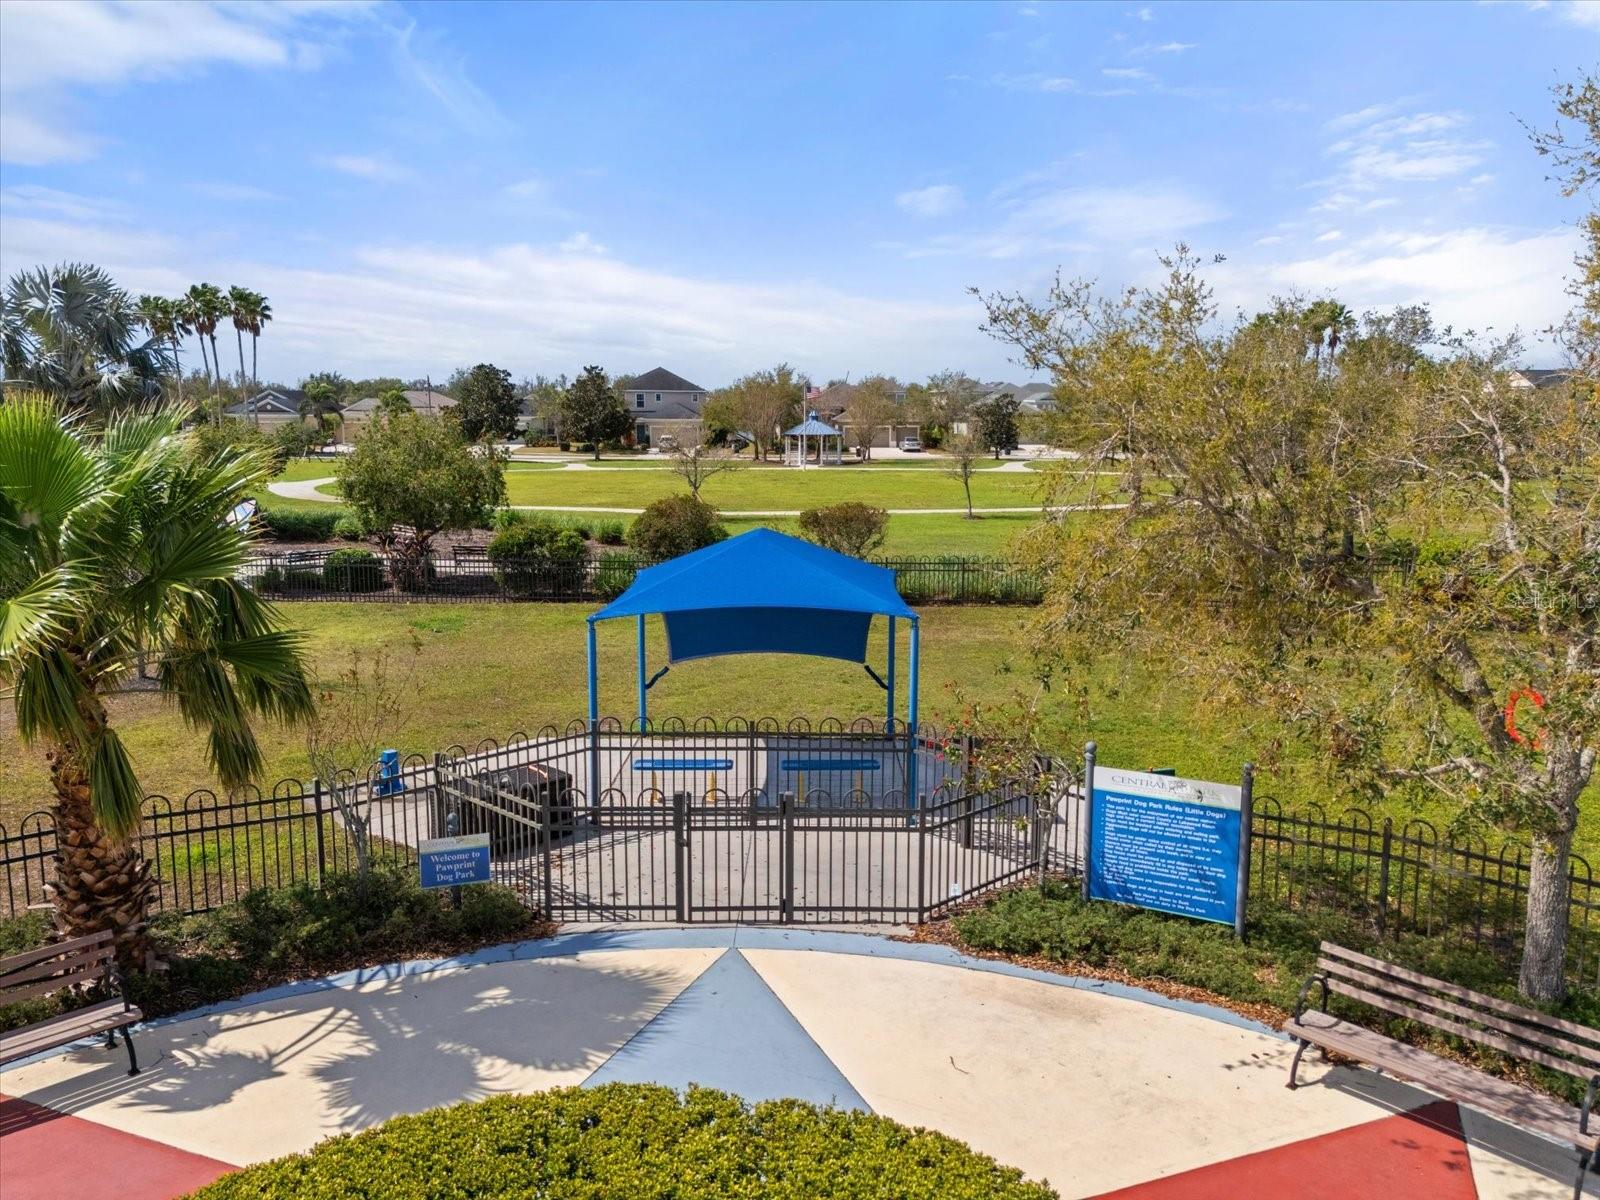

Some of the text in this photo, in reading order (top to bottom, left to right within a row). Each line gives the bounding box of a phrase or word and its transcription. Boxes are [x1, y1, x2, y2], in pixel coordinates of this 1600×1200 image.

[1111, 775, 1165, 789] CENTRAL
[1105, 795, 1226, 819] Pawprint Dog Park Rules (Little Dogs)
[430, 853, 470, 863] Welcome
[435, 861, 476, 872] Pawprint
[436, 870, 475, 882] Dog Park
